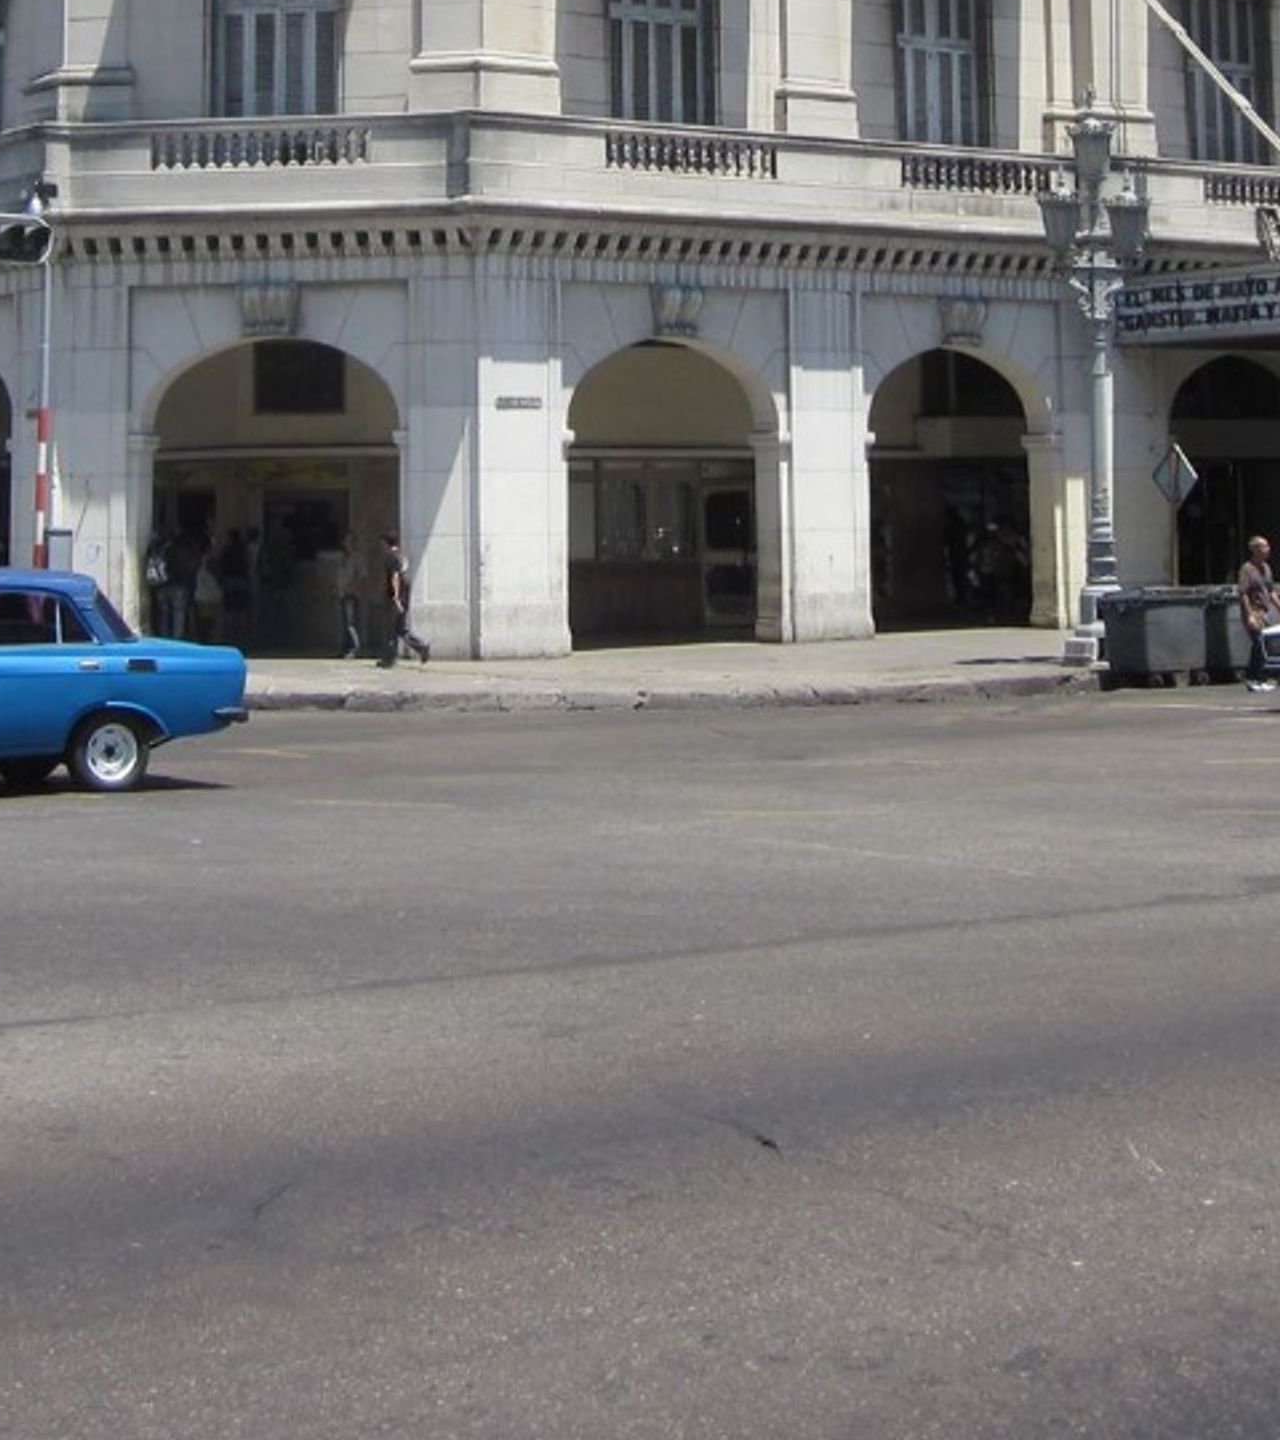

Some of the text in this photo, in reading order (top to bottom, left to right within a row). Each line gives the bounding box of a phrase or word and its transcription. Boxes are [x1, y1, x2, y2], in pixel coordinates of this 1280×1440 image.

[1151, 285, 1185, 303] MES
[1193, 282, 1213, 301] DE
[1220, 277, 1268, 299] MAYO
